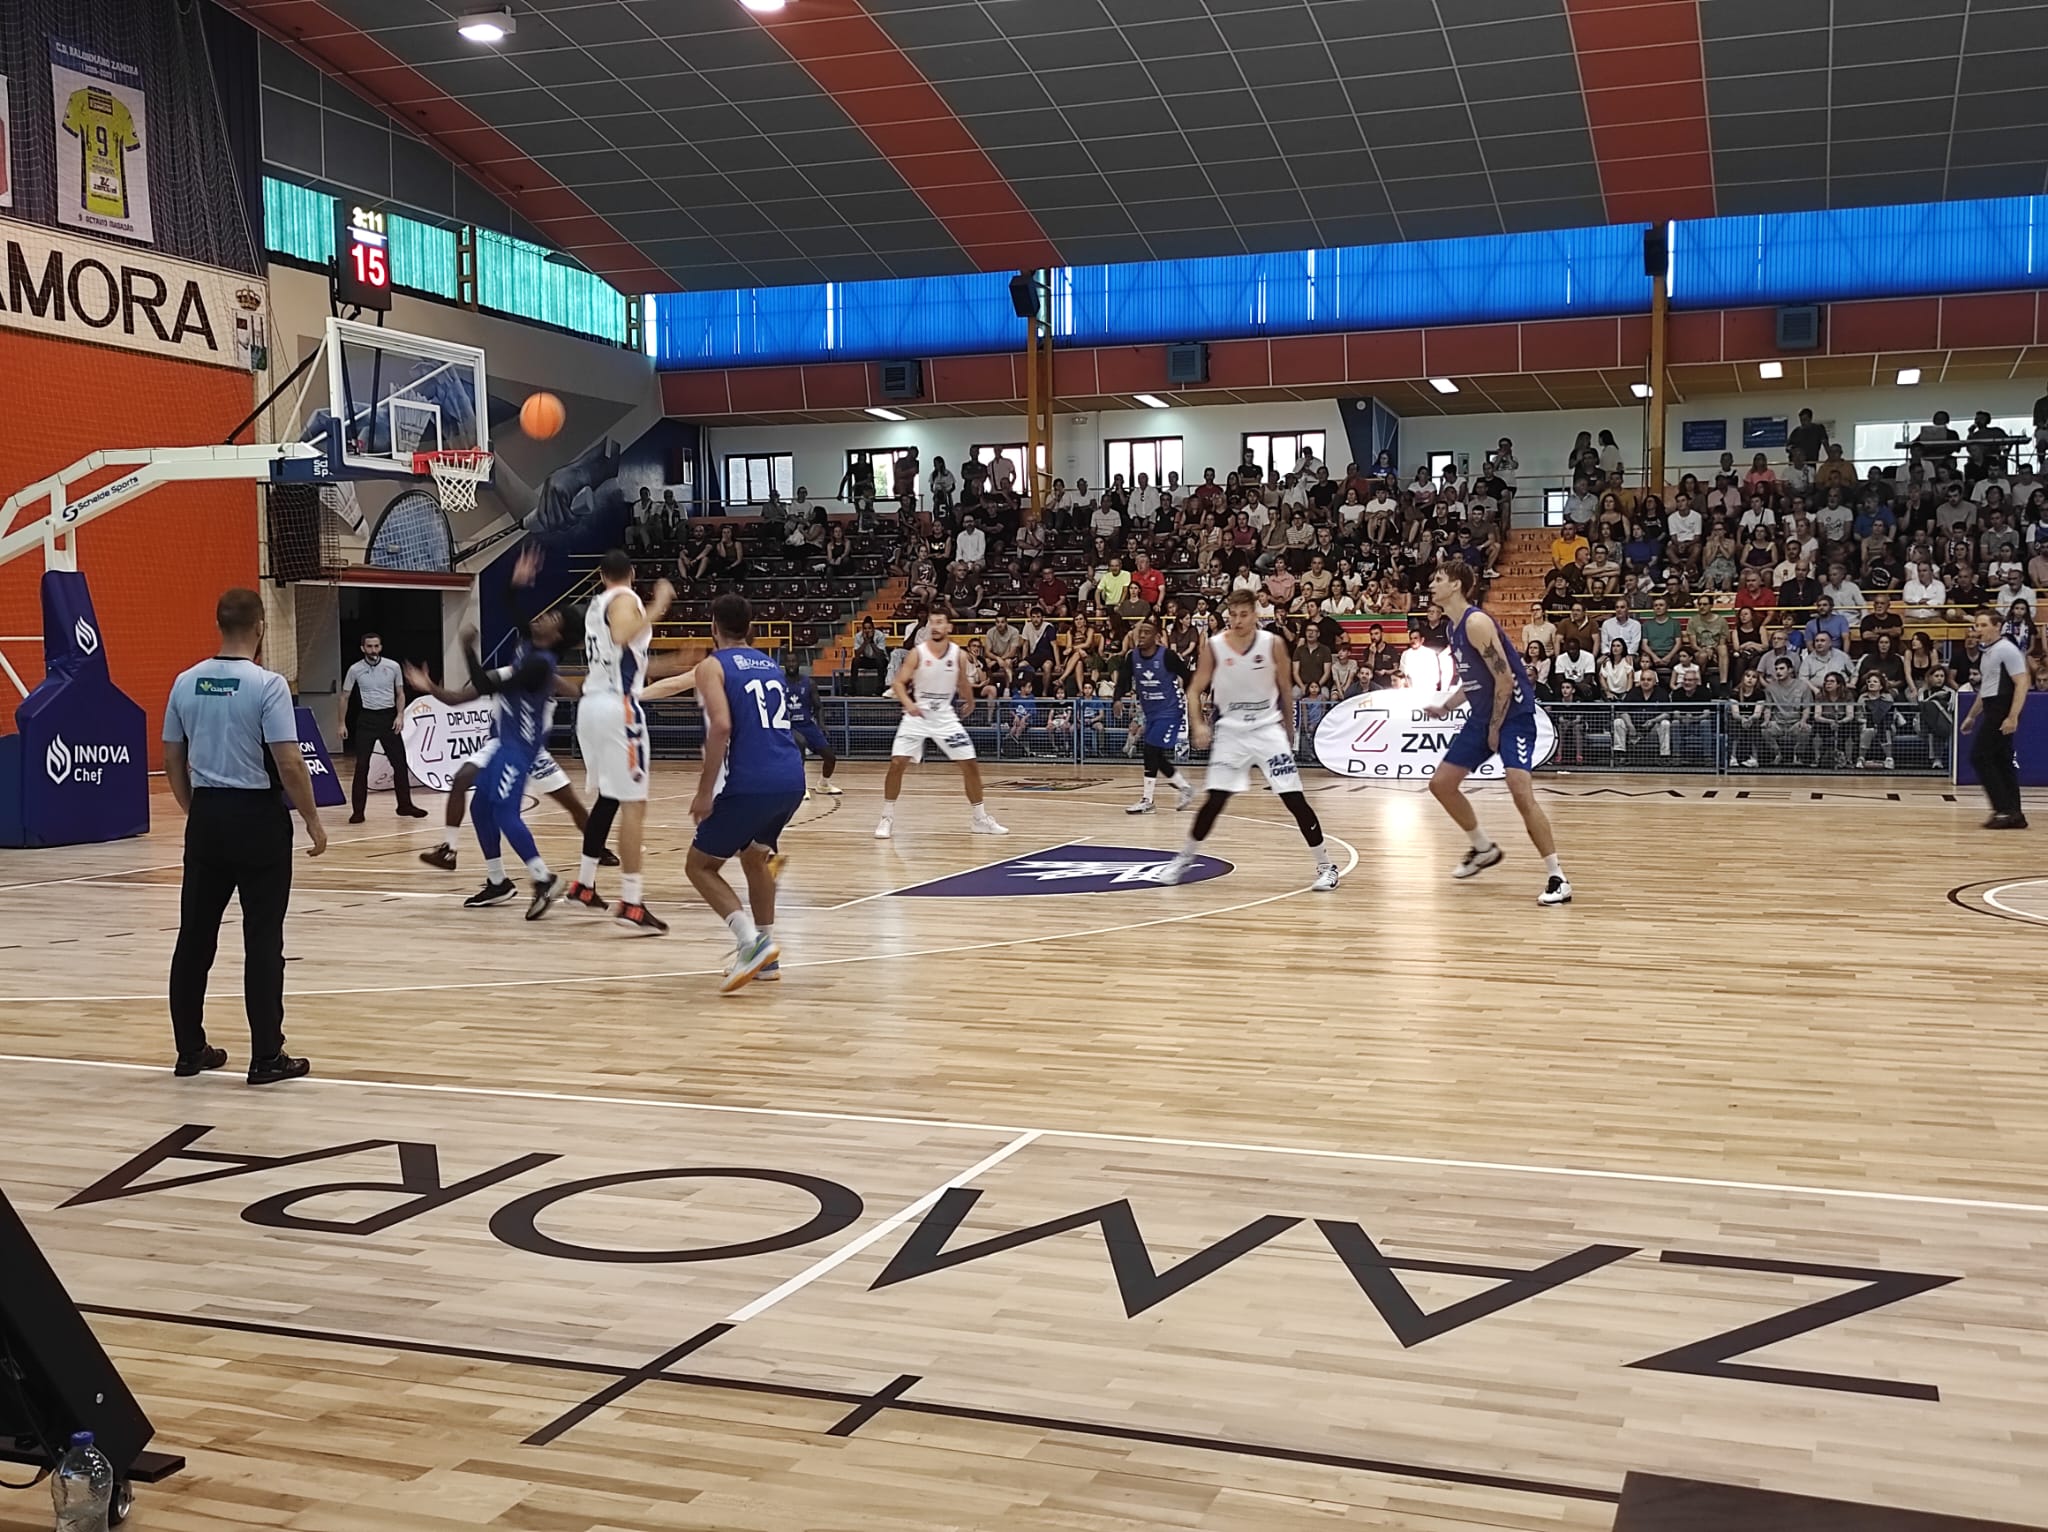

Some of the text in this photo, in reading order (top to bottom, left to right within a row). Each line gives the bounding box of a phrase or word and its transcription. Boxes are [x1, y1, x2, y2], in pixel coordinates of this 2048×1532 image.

[96, 126, 108, 156] 9
[351, 243, 385, 286] 15
[0, 240, 218, 350] MORA
[77, 490, 110, 510] Schelde
[111, 476, 138, 494] Sports
[744, 679, 791, 729] 12
[74, 745, 130, 763] INNOVA
[74, 768, 103, 785] Chef
[56, 1124, 1964, 1401] ZAMORA
